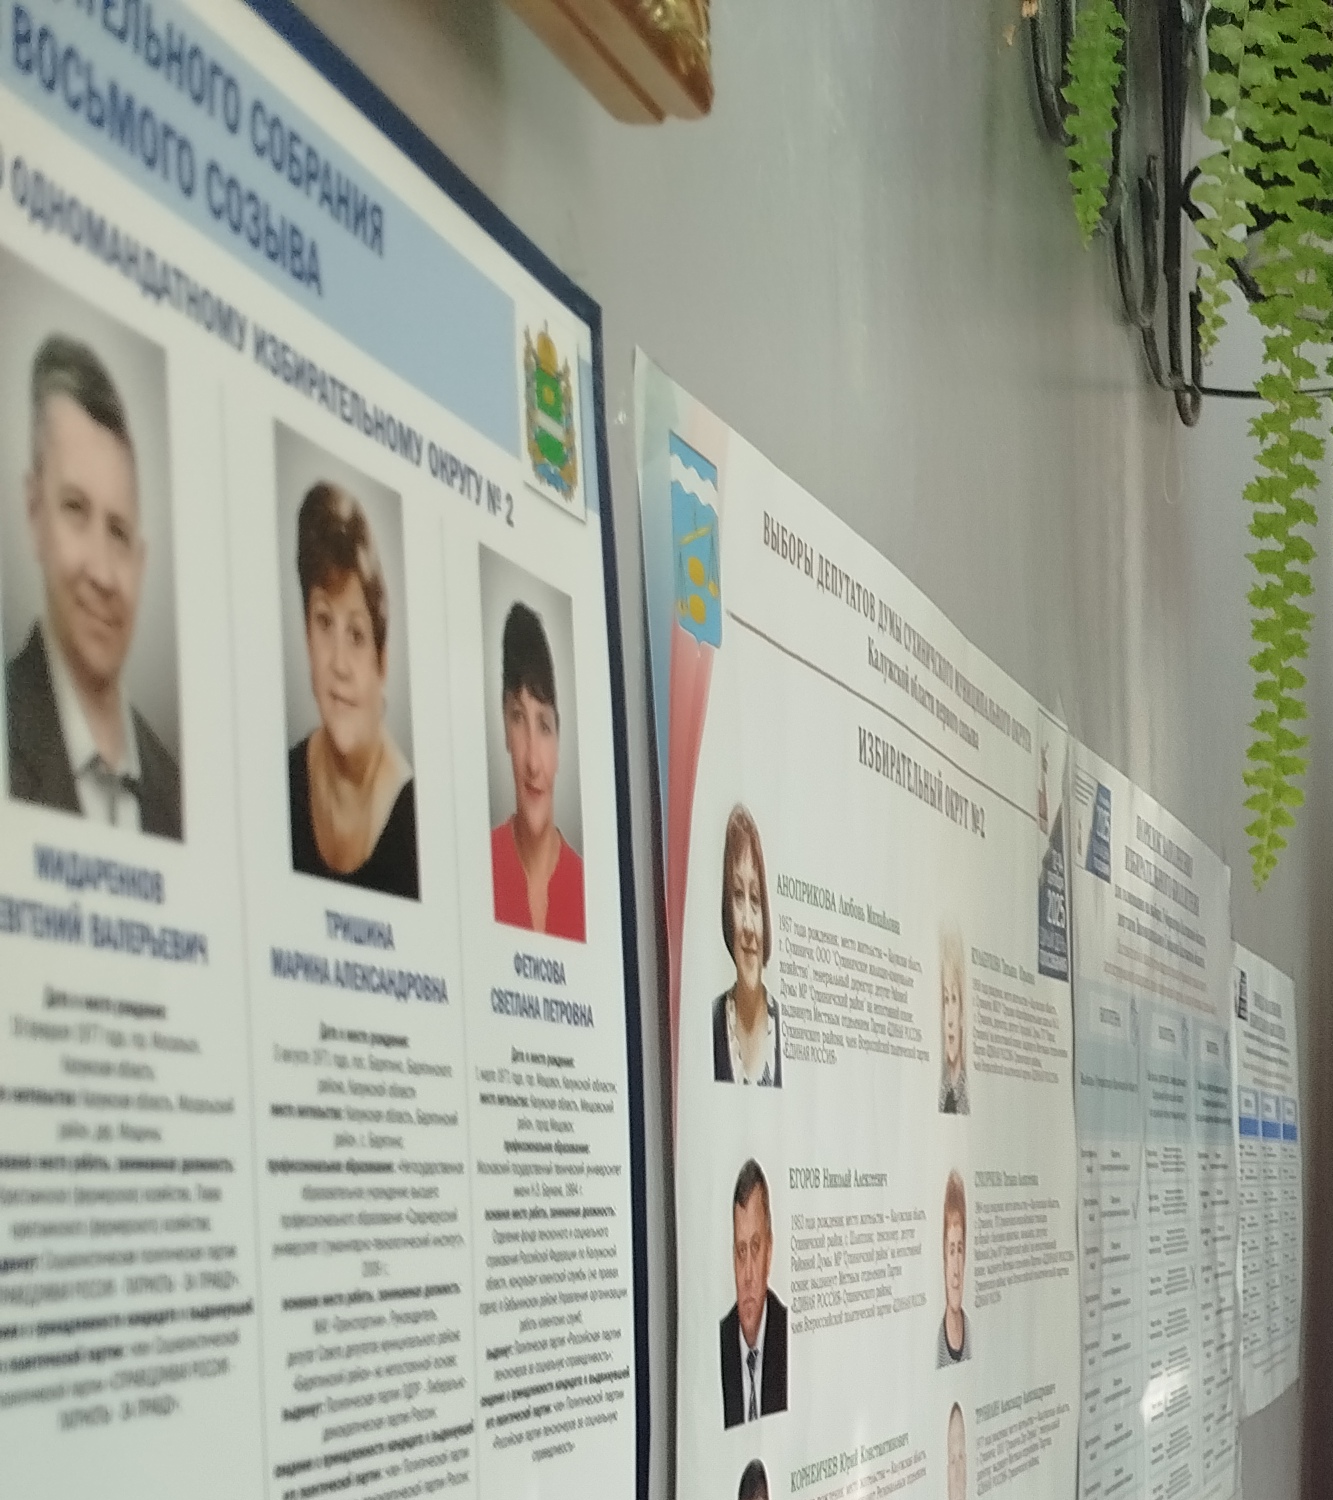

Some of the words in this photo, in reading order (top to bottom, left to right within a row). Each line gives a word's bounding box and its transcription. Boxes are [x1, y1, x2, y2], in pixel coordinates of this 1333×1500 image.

[13, 5, 195, 198] ВОСЬМОГО
[206, 161, 323, 296] СОЗЫВА
[84, 0, 240, 133] ЕЛЬНОГО
[251, 99, 385, 258] СОБРАНИЯ
[11, 156, 246, 352] ОДНОМАНДАТНОМУ
[253, 322, 424, 468] ИЗБИРАТЕЛЬНОМУ
[428, 439, 484, 507] ОКРУГУ
[505, 492, 515, 528] 2
[763, 510, 814, 580] ВЫБОРЫ
[816, 552, 876, 622] ДЕПУТАТОВ
[878, 598, 902, 645] ДУМЫ
[858, 725, 943, 814] ИЗБИРАТЕЛЬНЫЙ
[945, 787, 969, 832] ОКРУГ
[776, 873, 837, 912] АНОПРИКОВА
[335, 959, 449, 1005] АЛЕКСАНДРОВНА
[514, 950, 567, 986] ФЕТИСОВА
[491, 987, 542, 1021] СВЕТЛАНА
[543, 997, 595, 1028] ПЕТРОВНА
[789, 1167, 820, 1189] ЕГОРОВ
